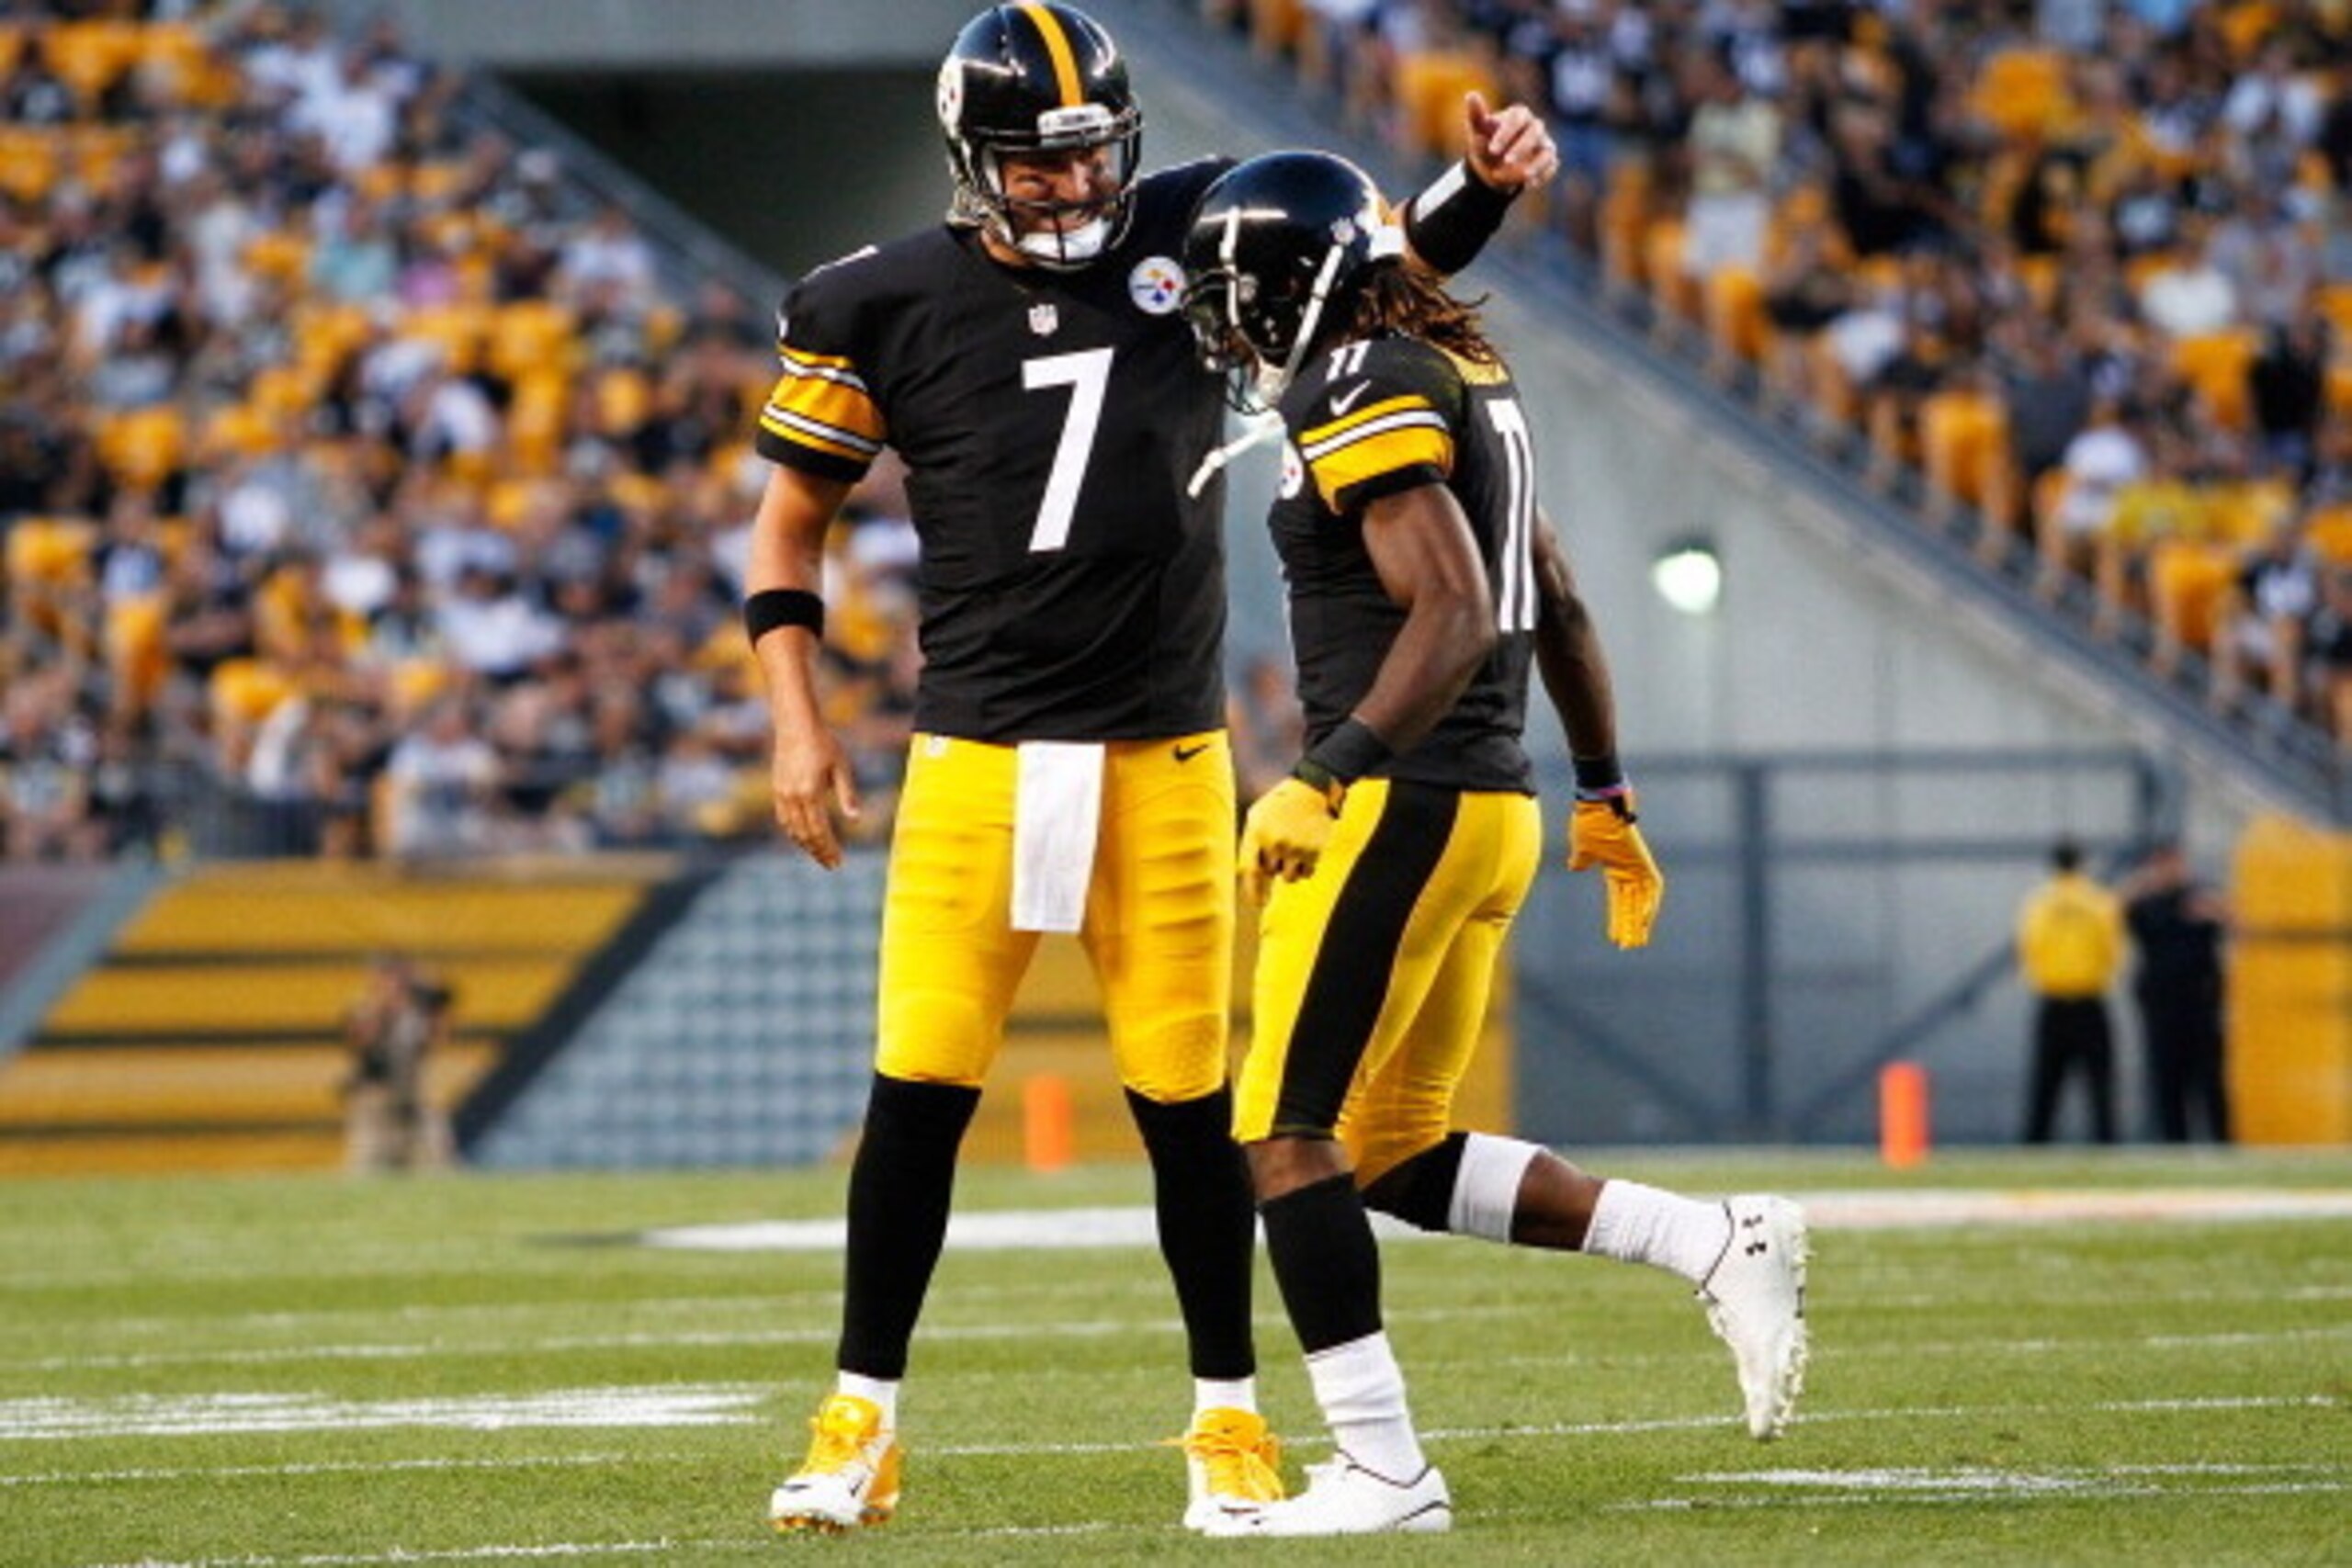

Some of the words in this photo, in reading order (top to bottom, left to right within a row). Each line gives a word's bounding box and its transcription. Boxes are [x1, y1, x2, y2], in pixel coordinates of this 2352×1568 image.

[1022, 346, 1114, 552] 7
[1326, 339, 1372, 381] 11
[1486, 399, 1535, 631] 11
